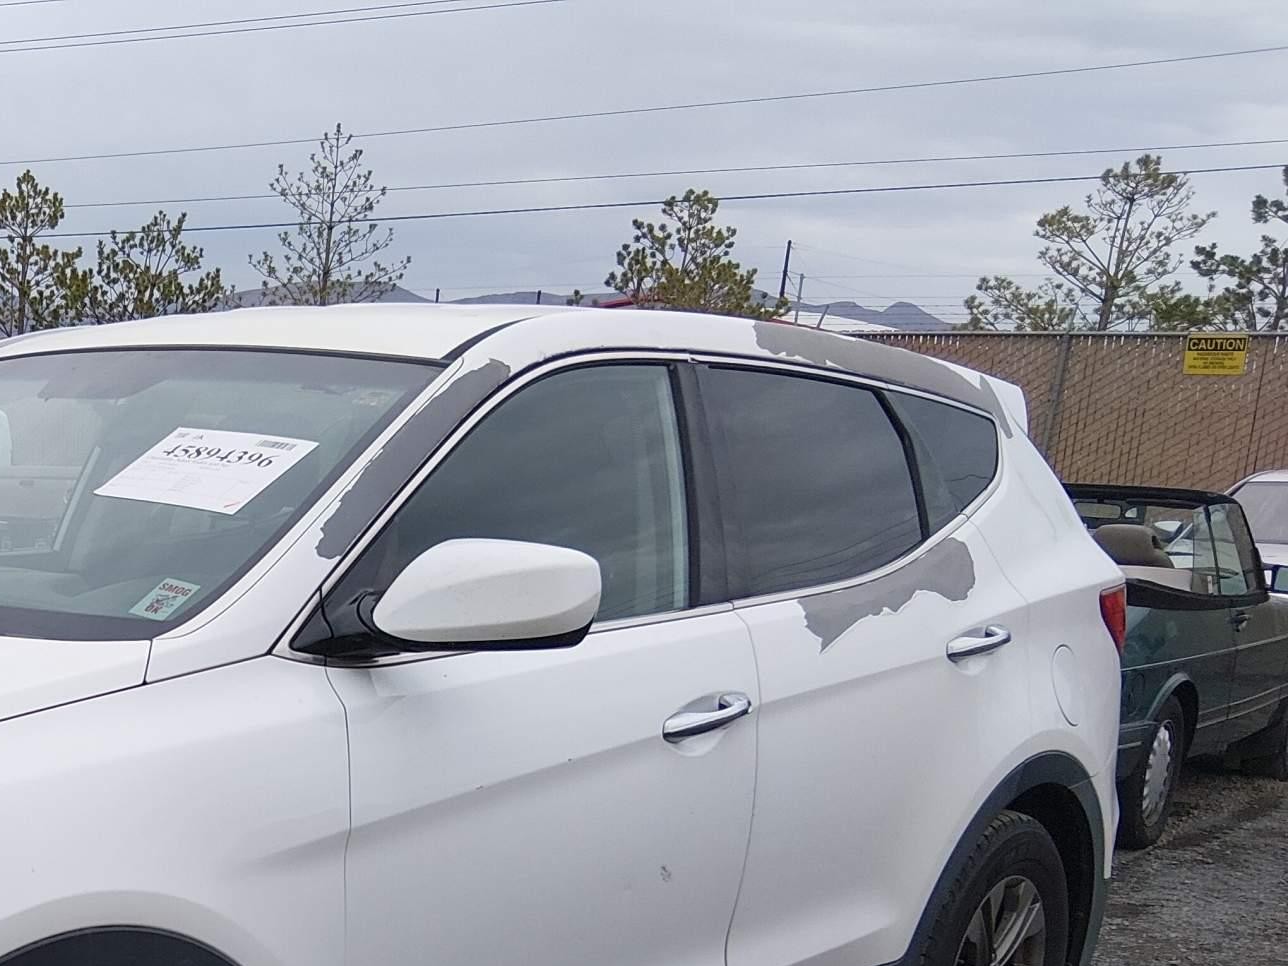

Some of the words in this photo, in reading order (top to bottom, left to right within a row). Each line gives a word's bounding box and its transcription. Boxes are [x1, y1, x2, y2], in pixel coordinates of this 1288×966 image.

[1190, 339, 1245, 350] CAUTION
[162, 443, 281, 469] 45894396
[159, 582, 192, 597] SMOG
[144, 602, 163, 615] OK
